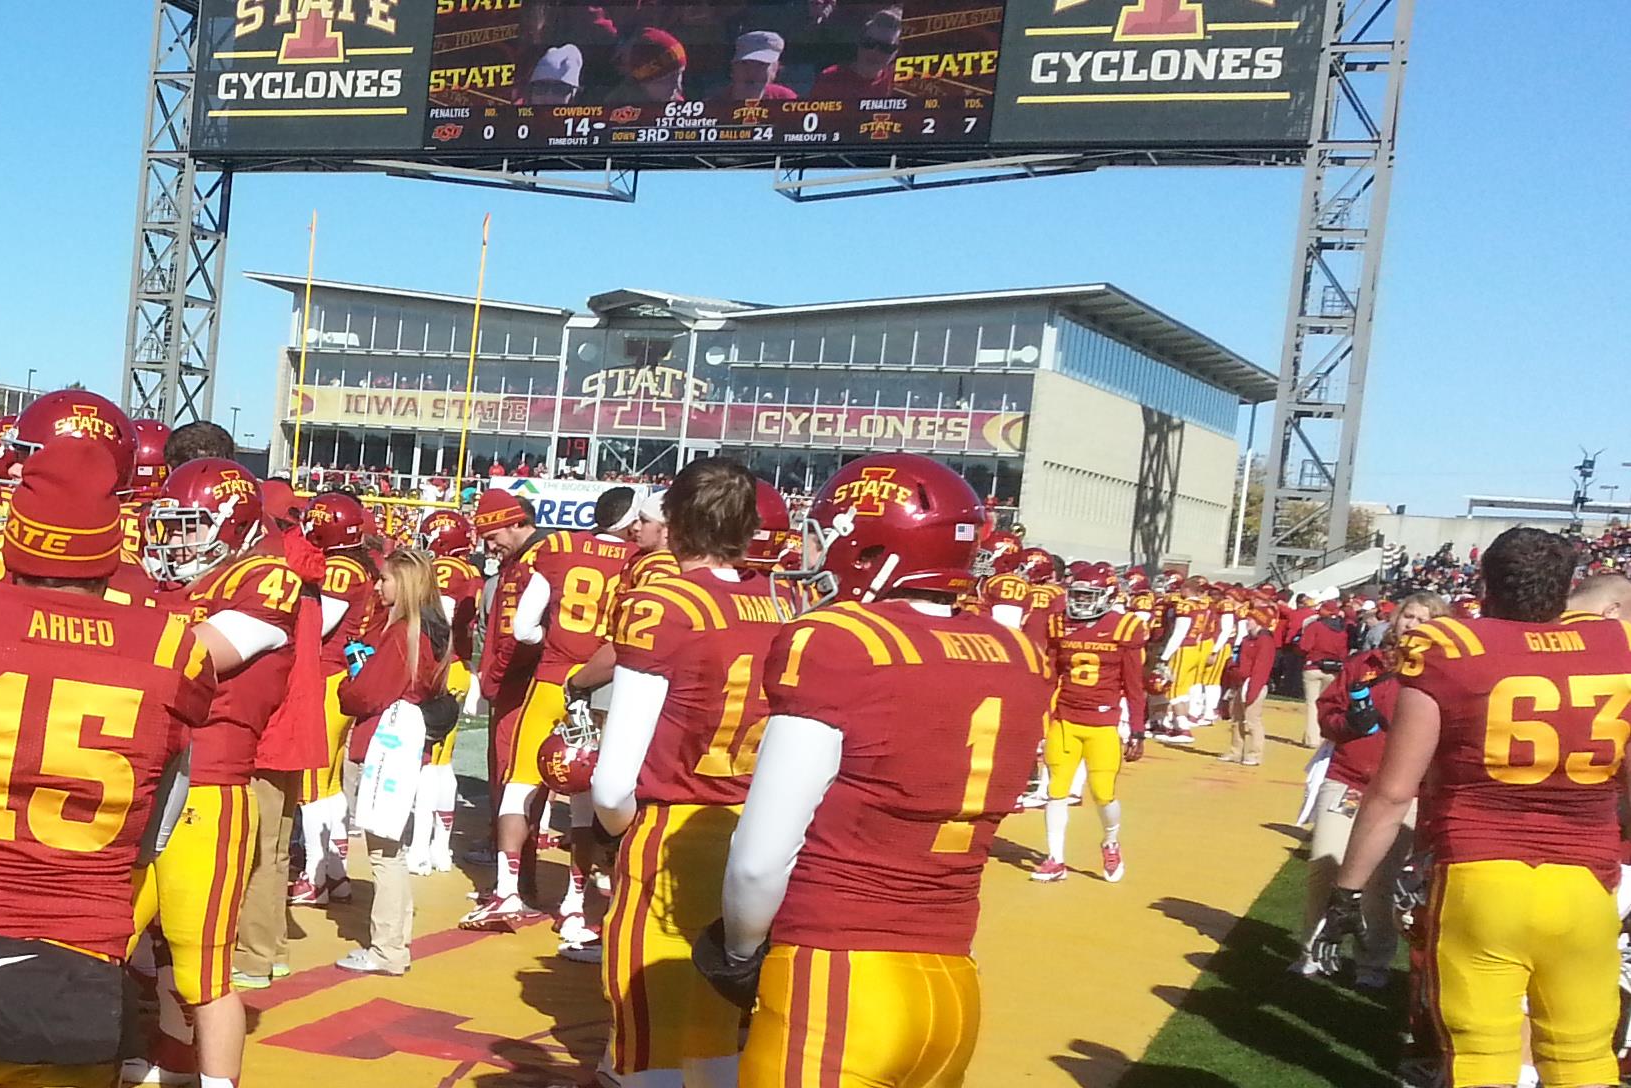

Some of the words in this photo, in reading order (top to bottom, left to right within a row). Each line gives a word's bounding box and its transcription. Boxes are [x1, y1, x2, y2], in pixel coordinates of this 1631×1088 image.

[925, 17, 966, 33] IOWA
[894, 51, 998, 82] STATE
[1031, 47, 1284, 84] CYCLONES
[218, 69, 402, 100] CYCLONES
[429, 64, 516, 93] STATE
[430, 108, 470, 118] PENALTIES
[553, 106, 603, 117] COWBOYS
[665, 101, 704, 117] 6:49
[733, 107, 768, 119] STATE
[782, 102, 842, 112] CYCLONES
[860, 99, 907, 110] PENALTIES
[564, 118, 590, 137] 14
[655, 118, 674, 126] 1ST
[676, 117, 718, 127] Quarter
[803, 113, 818, 132] 0
[859, 123, 902, 134] STATE
[922, 119, 935, 133] 2
[964, 118, 976, 133] 7
[483, 126, 494, 139] 0
[518, 125, 529, 139] 0
[612, 131, 636, 141] DOWN
[637, 129, 669, 142] 3RD
[674, 131, 684, 140] TO
[685, 131, 696, 140] GO
[699, 129, 717, 141] 10
[720, 130, 738, 140] BALL
[739, 130, 751, 139] ON
[753, 128, 773, 141] 24
[784, 134, 826, 142] TIMEOUTS
[548, 138, 588, 146] TIMEOUTS
[580, 366, 708, 412] STATE
[345, 393, 422, 419] IOWA
[54, 416, 116, 440] STATE
[758, 410, 971, 442] CYCLONES
[213, 480, 256, 500] STATE
[835, 482, 912, 506] STATE
[536, 499, 598, 528] REG
[598, 543, 627, 560] WEST
[258, 567, 302, 614] 47
[323, 569, 351, 593] 10
[1001, 581, 1027, 600] 50
[1033, 593, 1049, 608] 15
[28, 609, 115, 647] ARCEO
[615, 597, 665, 651] 12
[1084, 641, 1117, 651] STATE
[1524, 630, 1586, 653] GLENN
[779, 627, 815, 687] 1
[1071, 652, 1100, 686] 8
[1484, 674, 1631, 785] 63
[932, 697, 1002, 853] 1
